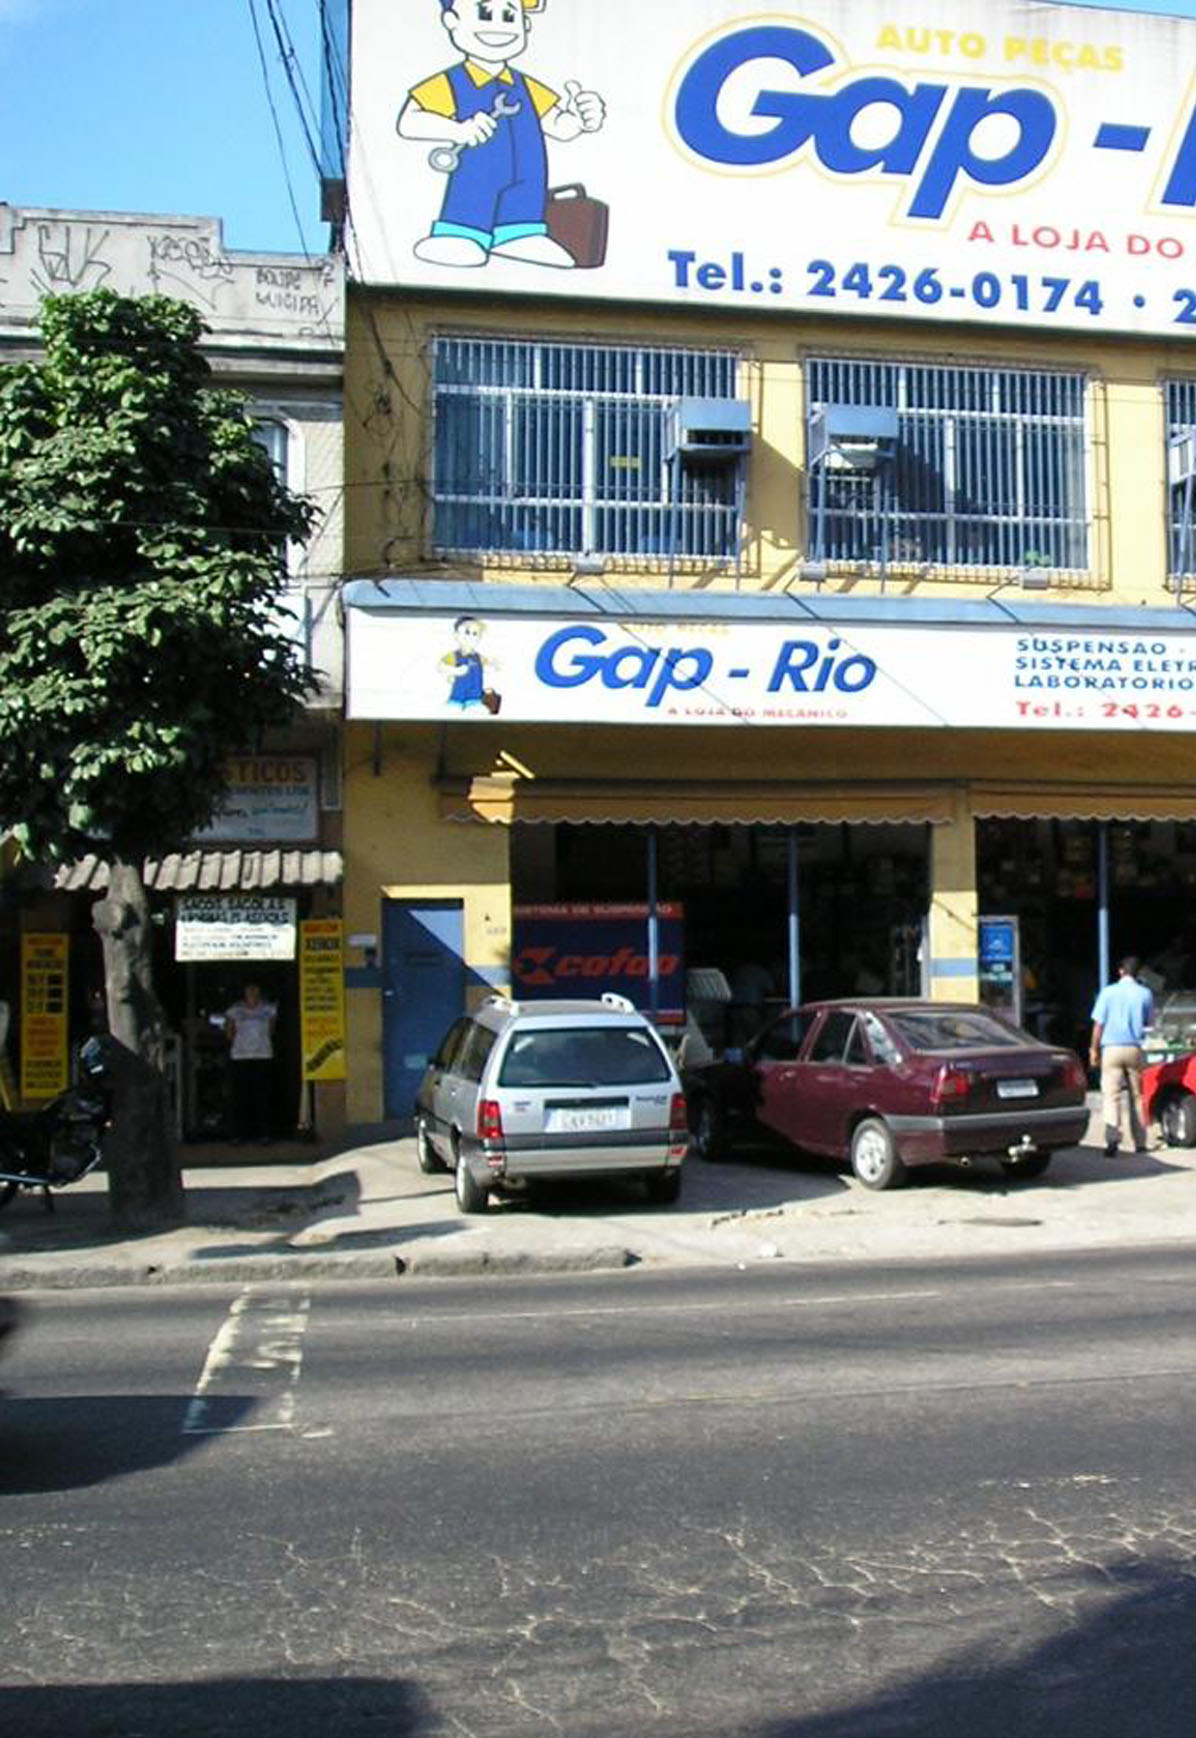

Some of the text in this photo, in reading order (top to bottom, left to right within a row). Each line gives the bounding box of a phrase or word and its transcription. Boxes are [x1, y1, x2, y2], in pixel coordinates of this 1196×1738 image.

[876, 25, 1124, 73] AUTO PEÇAS
[676, 28, 1055, 218] Gap
[967, 222, 993, 243] A
[1011, 225, 1108, 252] LOJA
[1126, 234, 1185, 259] DO
[668, 249, 781, 293] Tel.:
[806, 260, 1102, 315] 2426-0174
[534, 625, 714, 708] Gap
[766, 638, 877, 693] Rio
[1015, 656, 1122, 672] SISTEMA
